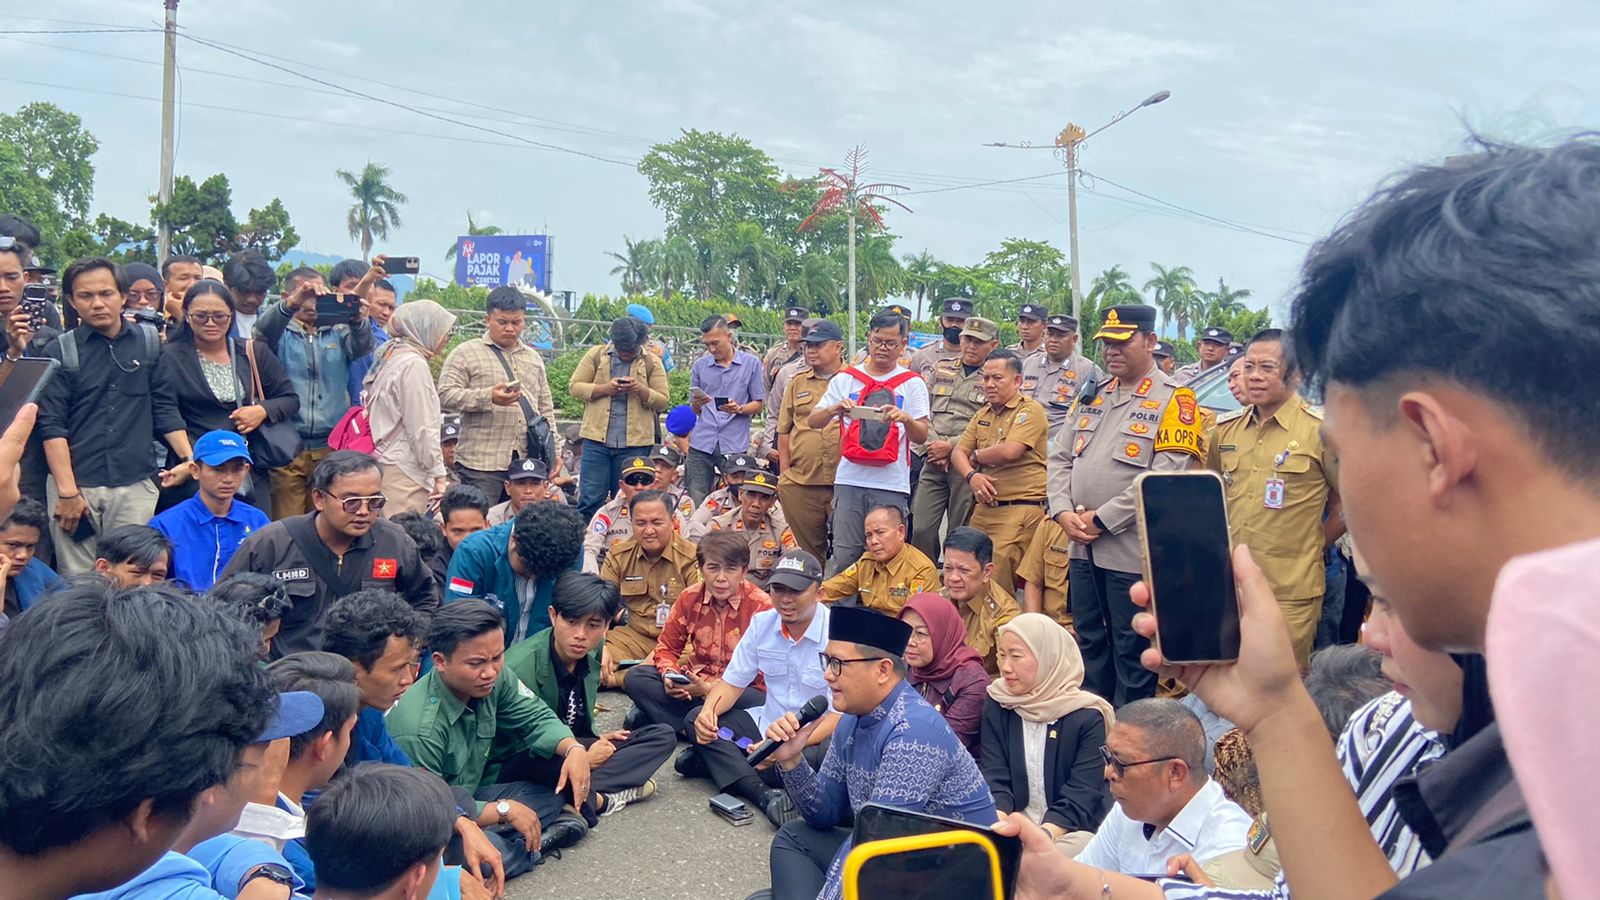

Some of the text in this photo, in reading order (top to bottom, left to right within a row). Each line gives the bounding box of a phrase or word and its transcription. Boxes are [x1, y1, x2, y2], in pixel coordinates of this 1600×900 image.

[467, 252, 500, 264] LAPOR
[467, 264, 500, 276] PAJAK
[1129, 411, 1159, 422] POLRI
[1156, 428, 1170, 445] KA
[1174, 429, 1194, 445] OPS
